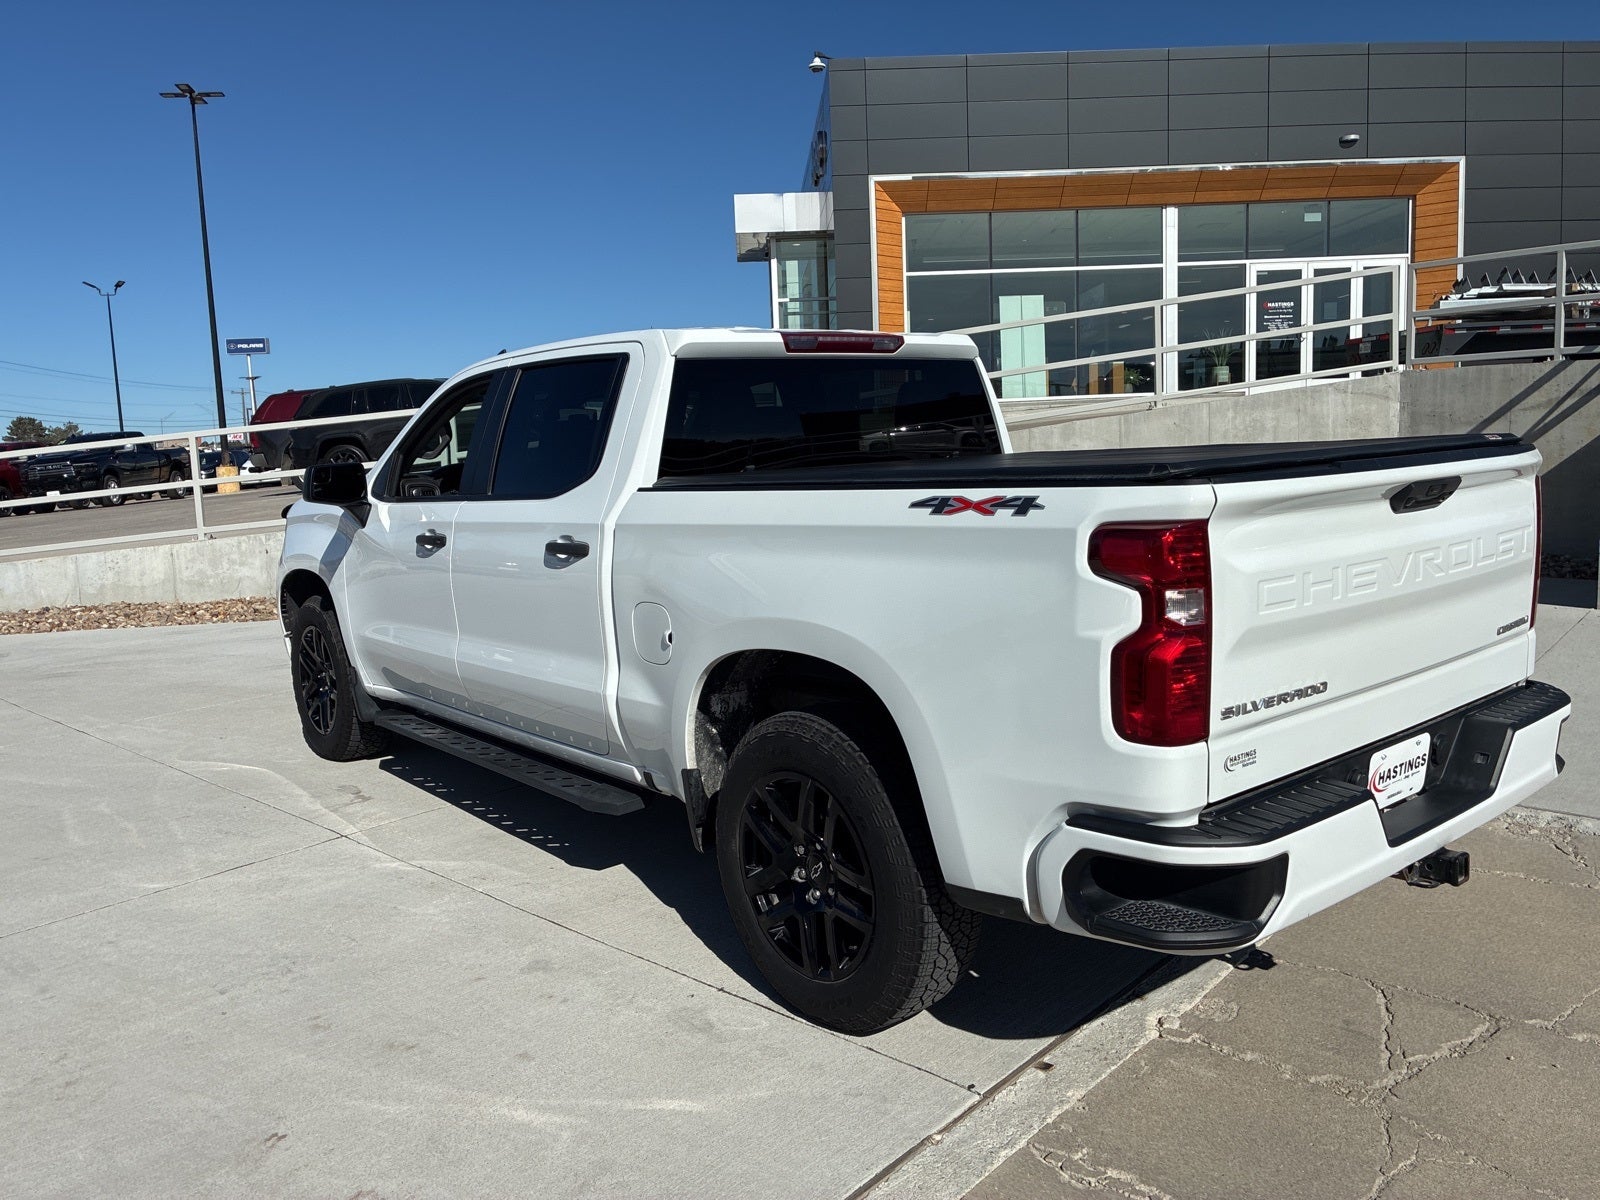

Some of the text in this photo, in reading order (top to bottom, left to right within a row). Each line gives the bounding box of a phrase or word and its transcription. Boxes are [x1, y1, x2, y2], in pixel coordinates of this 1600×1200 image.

[1257, 524, 1533, 615] CHEVROLET
[1220, 681, 1328, 721] SILVERADO
[1229, 749, 1256, 763] HASTINGS
[1378, 753, 1427, 785] HASTINGS
